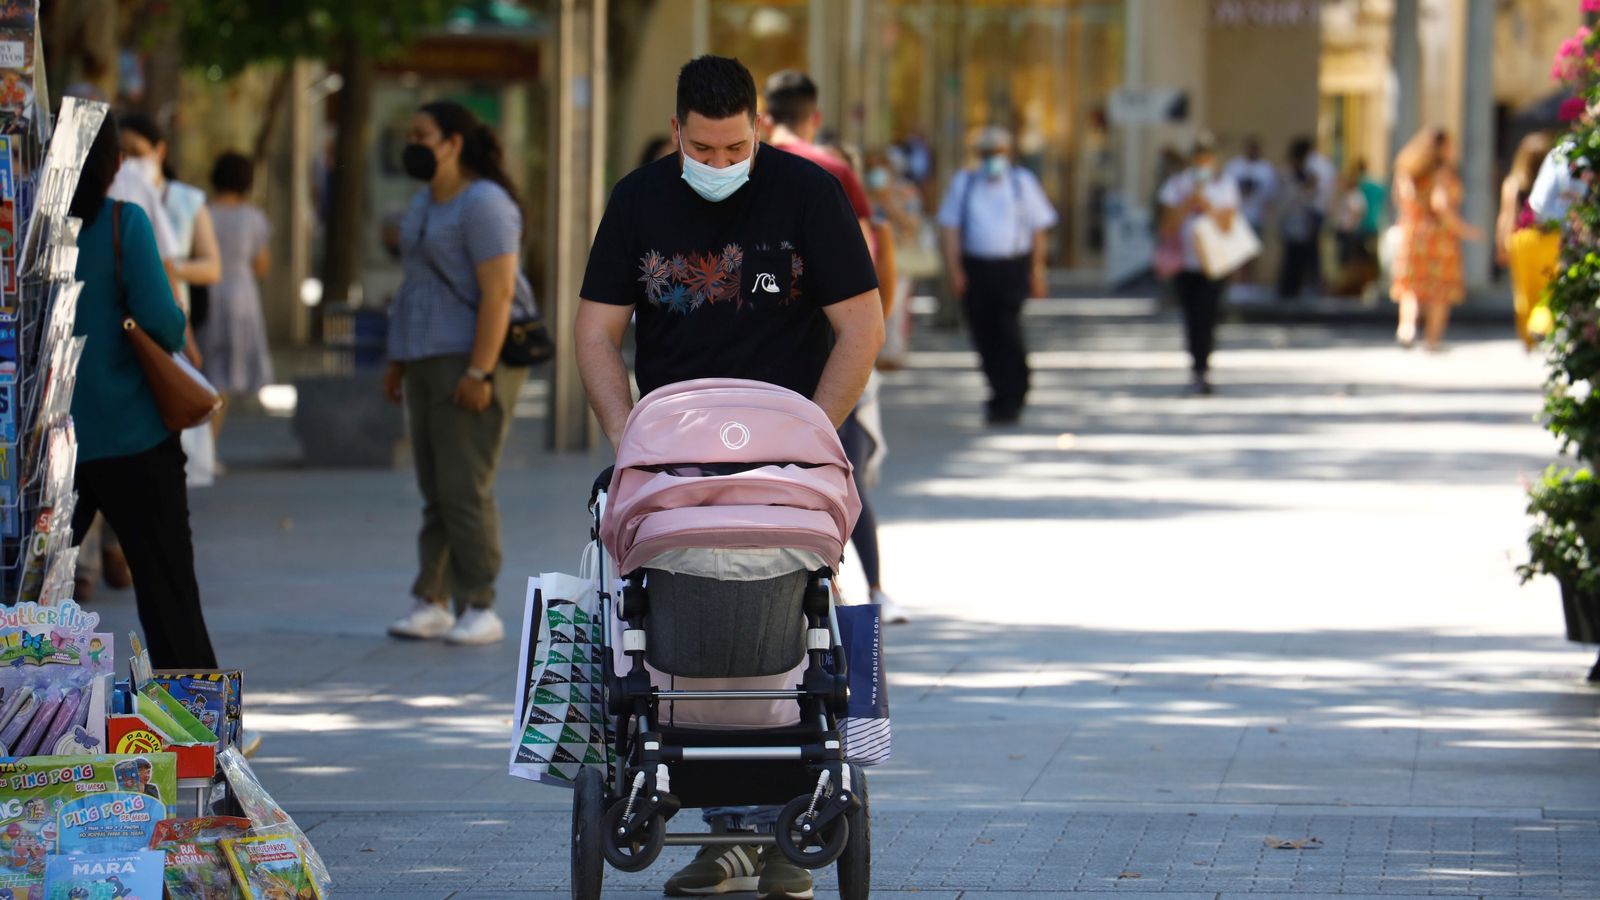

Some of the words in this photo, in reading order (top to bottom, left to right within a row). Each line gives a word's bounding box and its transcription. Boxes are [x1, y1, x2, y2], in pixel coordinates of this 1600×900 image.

[871, 616, 879, 705] www.paquidiaz.com
[11, 771, 48, 790] PING
[50, 763, 94, 784] PONG
[63, 807, 100, 829] PING
[101, 795, 145, 818] PONG
[130, 812, 150, 823] MESA
[73, 861, 136, 875] MARA
